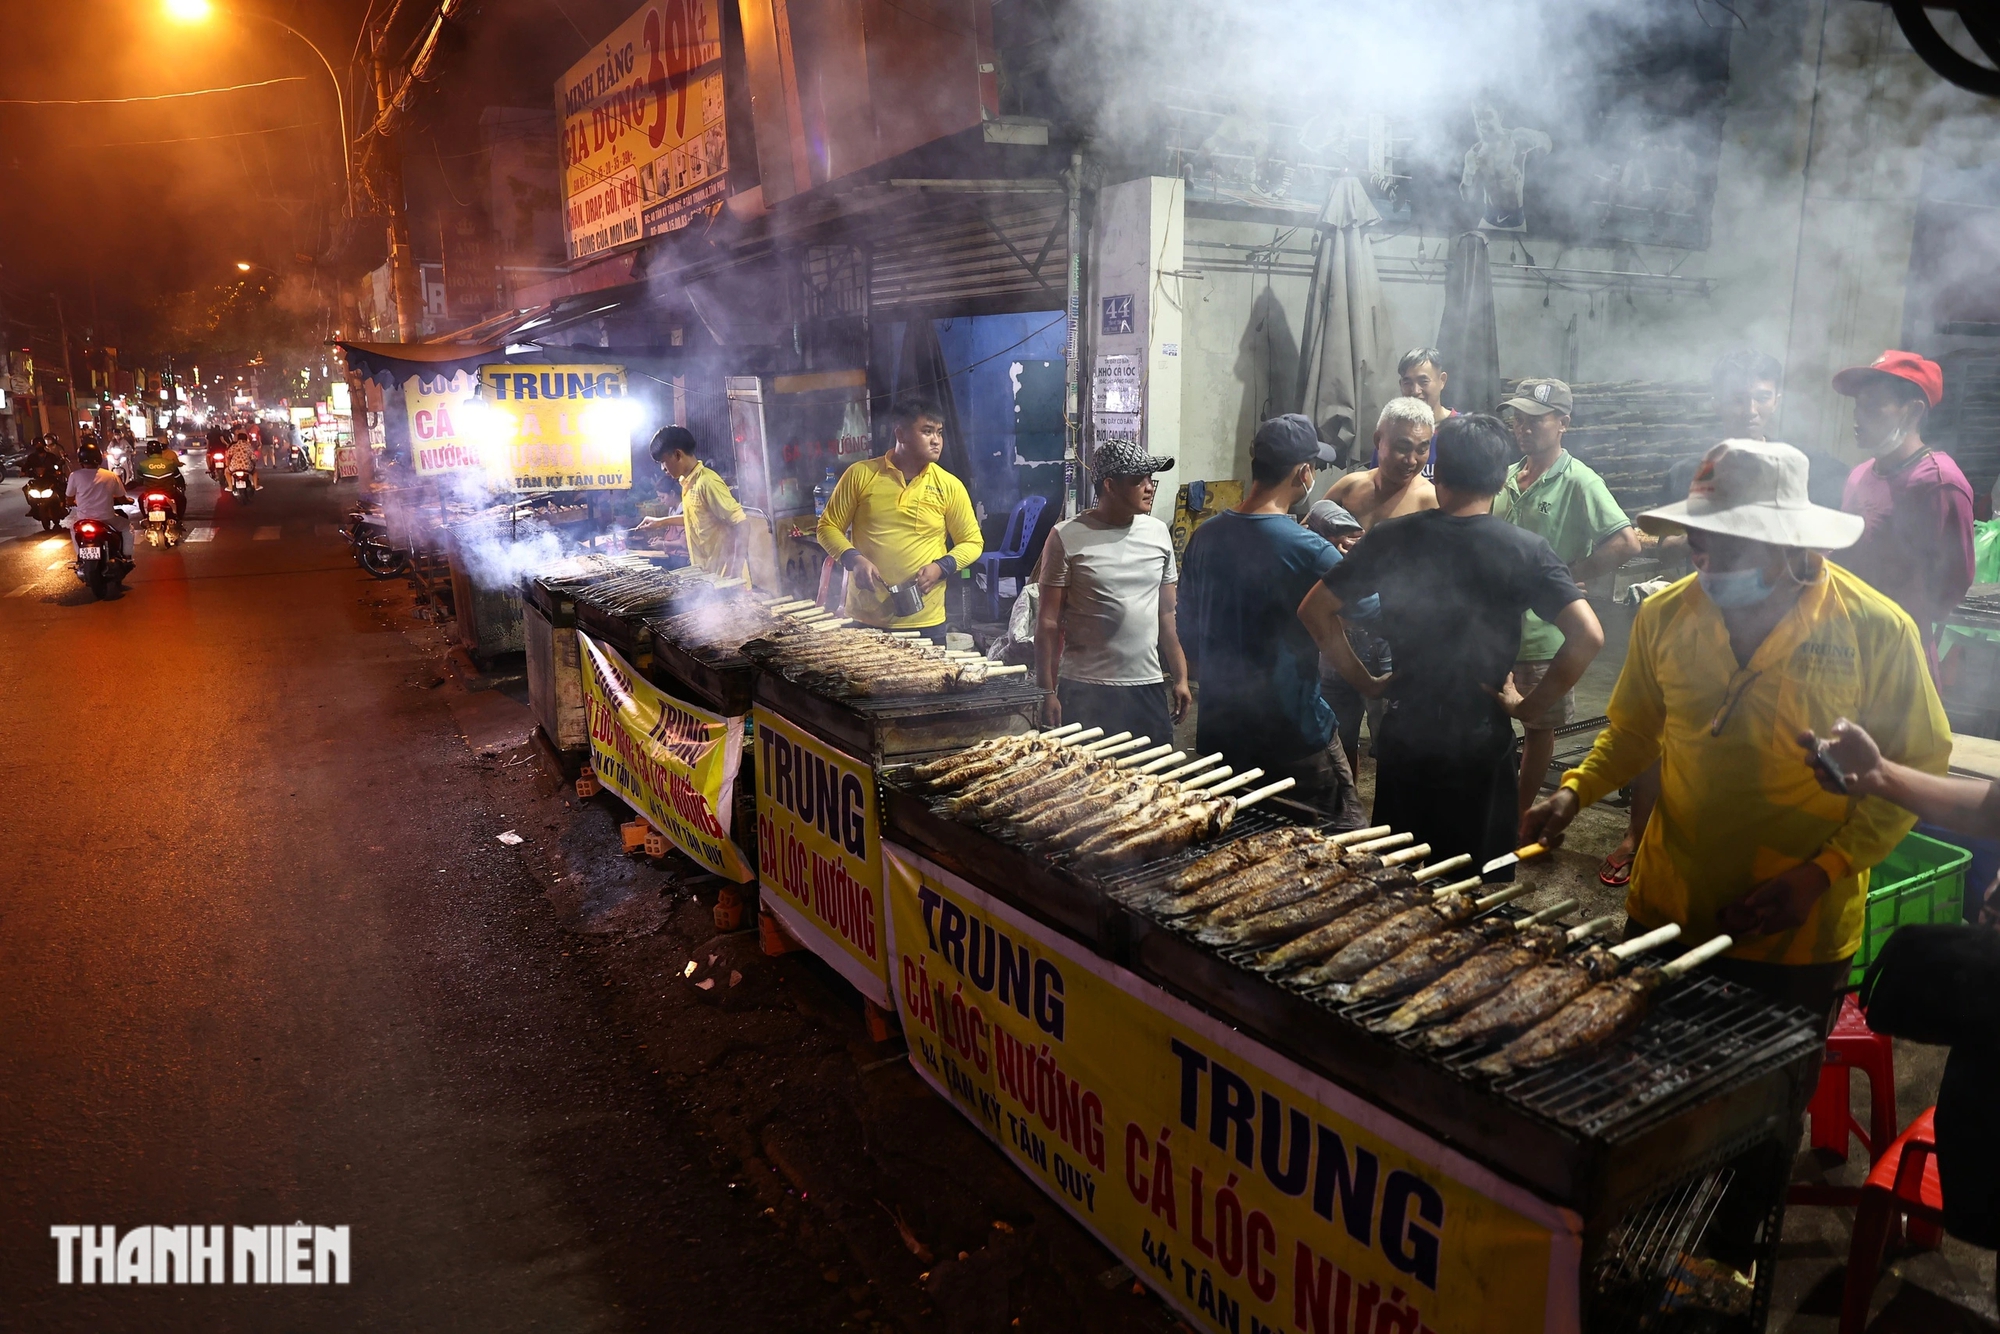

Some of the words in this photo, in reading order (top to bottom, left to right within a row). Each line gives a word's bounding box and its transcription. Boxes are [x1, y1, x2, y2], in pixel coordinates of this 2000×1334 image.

[564, 74, 593, 120] MINH
[596, 43, 634, 95] HẰNG
[561, 123, 590, 170] GIA
[592, 76, 646, 156] DỤNG
[585, 195, 605, 224] DRAP,
[620, 175, 639, 212] NỆM
[571, 234, 579, 259] ĐỒ
[579, 231, 596, 256] DÙNG
[595, 224, 610, 249] CỦA
[610, 221, 623, 246] MỌI
[623, 213, 639, 240] NHÀ
[1106, 298, 1130, 318] 44
[489, 373, 620, 400] TRUNG
[1123, 364, 1135, 376] LÓC
[415, 403, 455, 439] CÁ
[148, 462, 166, 470] Grab
[420, 443, 480, 470] NƯỚNG
[515, 474, 542, 488] TÂN
[567, 472, 593, 486] TÂN
[592, 698, 613, 747] LÓC
[603, 754, 615, 778] KỲ
[616, 760, 630, 790] TÂN
[759, 724, 866, 861] TRUNG
[670, 773, 724, 840] NƯỚNG
[702, 841, 726, 869] QUÝ
[759, 812, 779, 884] CÁ
[780, 822, 811, 909] LÓC
[812, 855, 877, 961] NƯỚNG
[918, 885, 1066, 1043] TRUNG
[904, 955, 937, 1035] CÁ
[942, 979, 988, 1074] LÓC
[994, 1028, 1106, 1173] NƯỚNG
[919, 1036, 939, 1070] 44
[941, 1055, 977, 1108] TÂN
[978, 1086, 1004, 1131] KỲ
[1007, 1111, 1047, 1172] TÂN
[1054, 1152, 1096, 1213] QUÝ
[1171, 1037, 1445, 1292] TRUNG
[1125, 1122, 1179, 1231] CÁ
[1191, 1165, 1277, 1303] LÓC
[1294, 1239, 1437, 1334] NƯỚ
[1141, 1228, 1174, 1283] 44
[1181, 1257, 1240, 1334] TÂN
